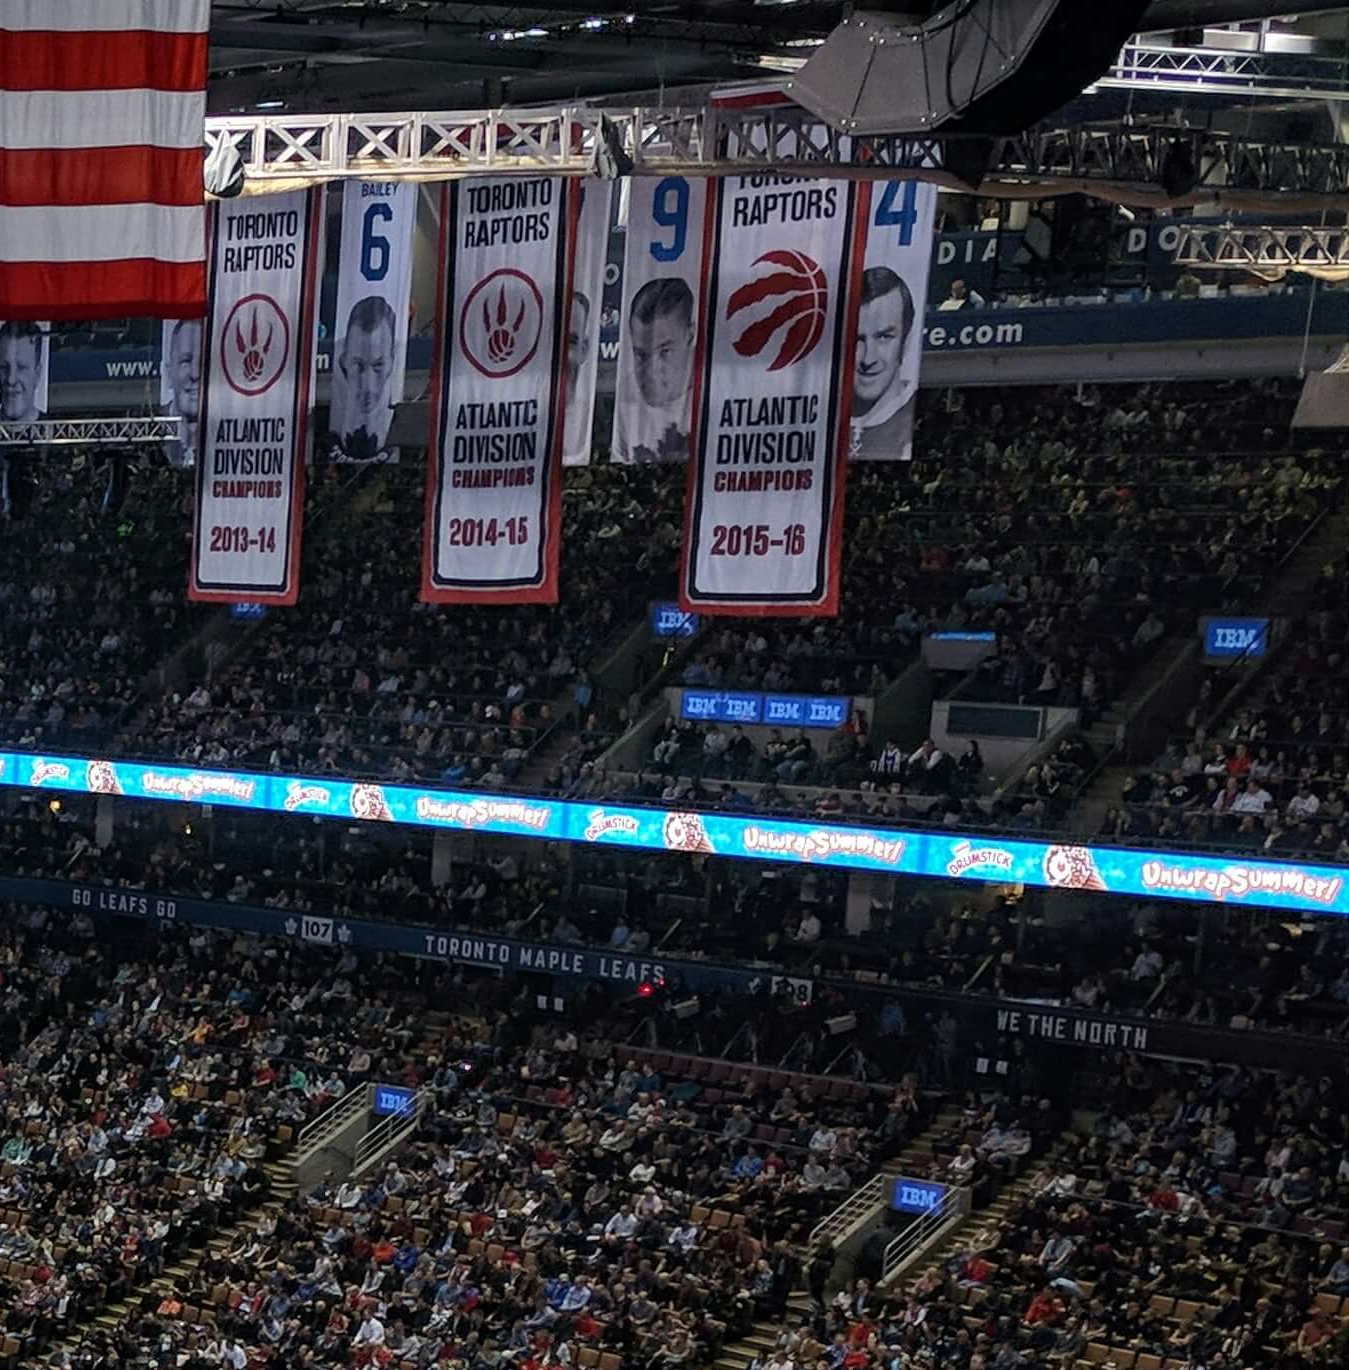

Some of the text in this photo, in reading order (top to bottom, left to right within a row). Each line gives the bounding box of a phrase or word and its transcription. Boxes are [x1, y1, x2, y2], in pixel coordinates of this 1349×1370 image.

[361, 182, 399, 197] BAILEY
[467, 177, 553, 214] TORONTO
[650, 176, 690, 262] 9
[733, 187, 837, 228] RAPTORS
[874, 180, 918, 247] 4
[226, 211, 298, 241] TORONTO
[465, 212, 550, 249] RAPTORS
[360, 202, 393, 281] 6
[224, 243, 296, 273] RAPTORS
[456, 399, 538, 430] ATLANTIC
[720, 395, 819, 428] ATLANTIC
[216, 418, 285, 443] ATLANTIC
[213, 449, 284, 476] DIVISION
[453, 432, 536, 464] DIVISION
[716, 431, 816, 466] DIVISION
[212, 480, 282, 499] CHAMPIONS
[452, 466, 535, 489] CHAMPIONS
[714, 469, 813, 493] CHAMPIONS
[210, 526, 277, 553] 2013-14
[449, 517, 529, 546] 2014-15
[710, 524, 806, 556] 2015-16
[1214, 628, 1256, 648] IBM
[687, 697, 716, 714] IBM
[727, 699, 756, 717] IBM
[769, 702, 800, 718] IBM
[810, 704, 841, 721] IBM
[949, 850, 1010, 875] DRUMSTICK
[72, 888, 176, 918] GO LEAFS GO
[303, 919, 331, 938] 107
[425, 935, 665, 984] TORONTO MAPLE LEAFS
[998, 1009, 1148, 1049] WE THE NORTH
[380, 1090, 412, 1113] IBM
[901, 1186, 938, 1208] IBM
